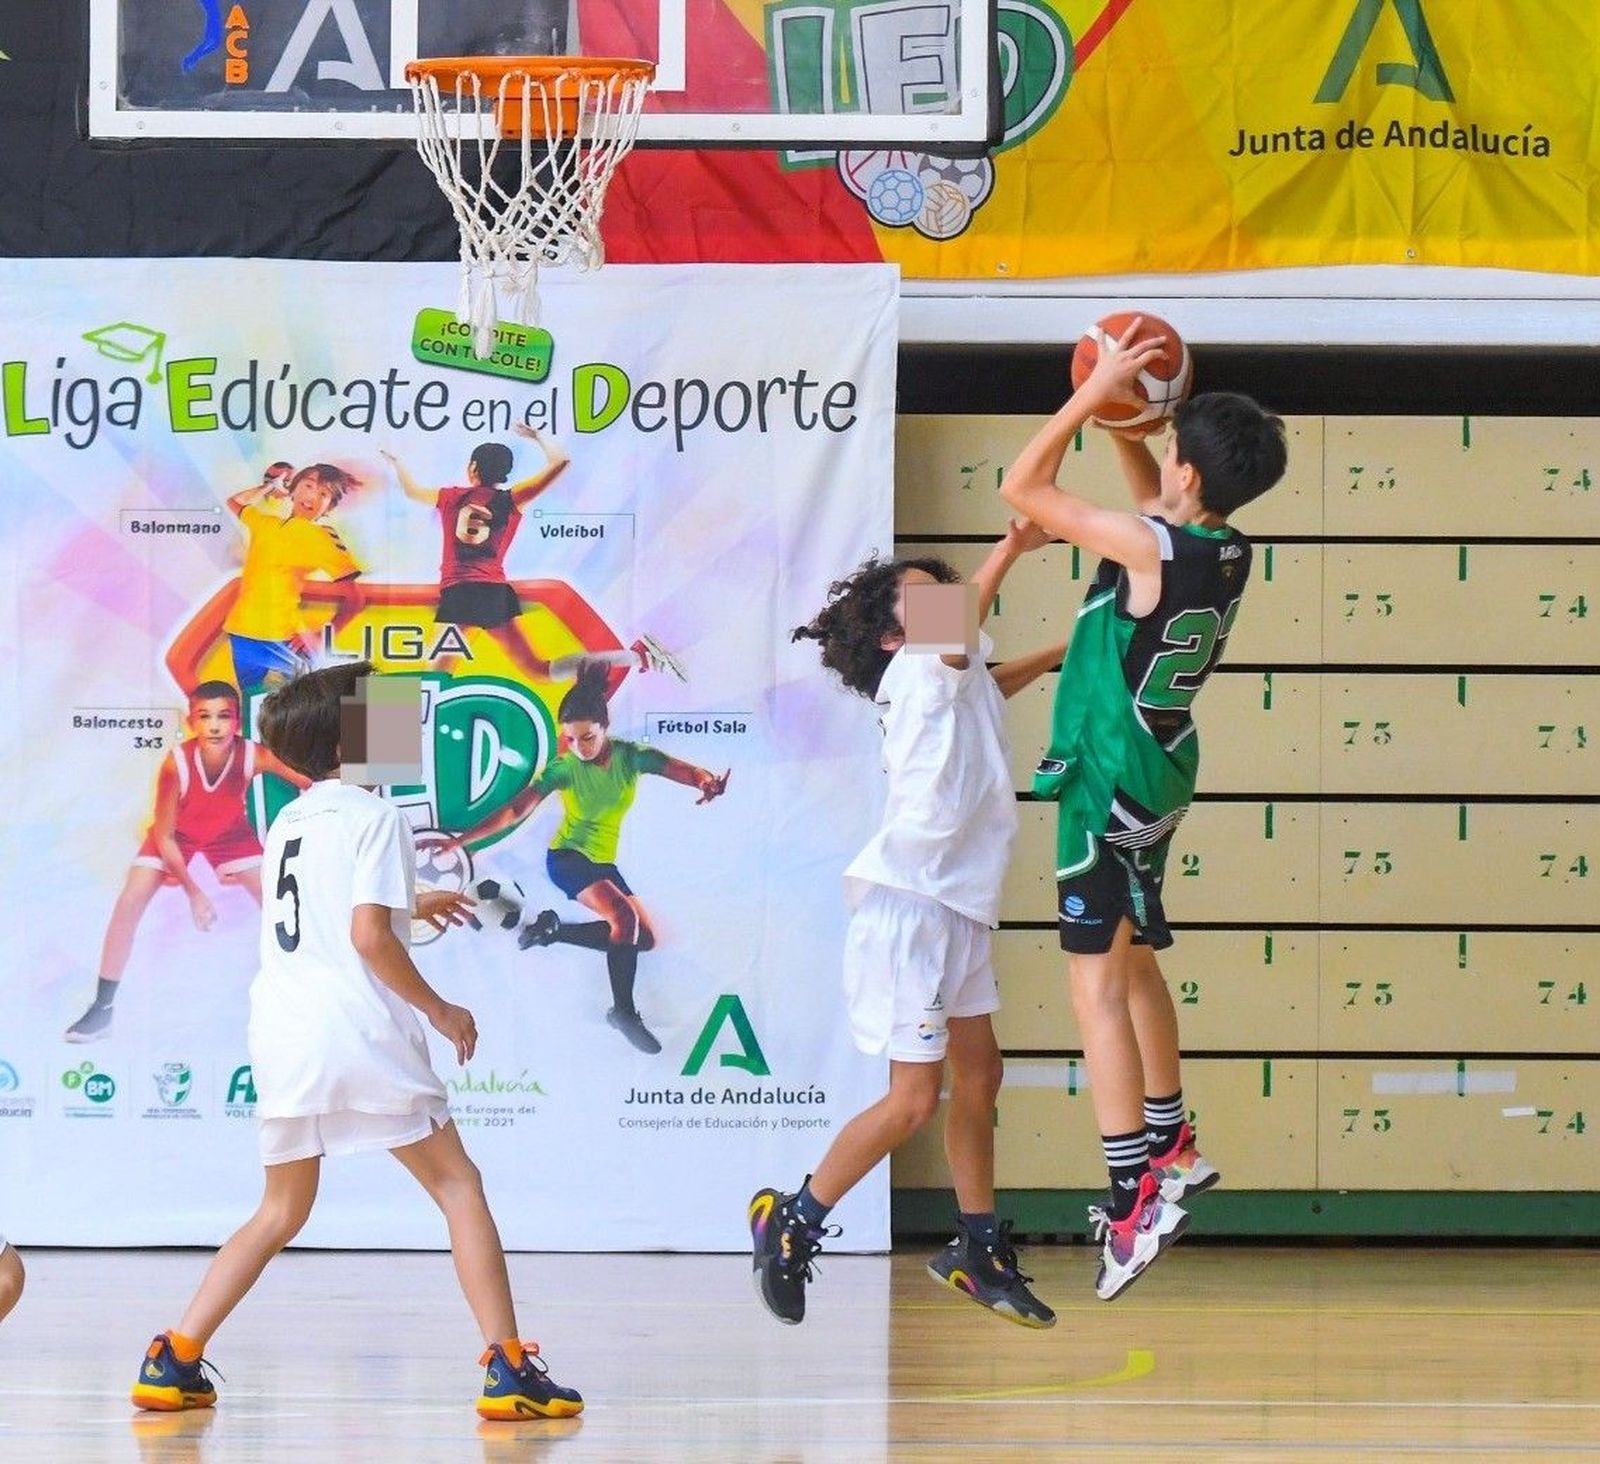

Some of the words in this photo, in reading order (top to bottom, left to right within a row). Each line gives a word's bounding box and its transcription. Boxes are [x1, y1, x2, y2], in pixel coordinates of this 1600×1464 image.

[1228, 124, 1326, 157] Junta
[1335, 120, 1374, 150] de
[1383, 119, 1551, 158] Andalucía
[420, 337, 458, 357] CON
[490, 351, 541, 372] COLE!
[2, 357, 143, 450] Liga
[165, 356, 451, 433] Edúcate
[462, 399, 512, 432] en
[523, 386, 558, 436] el
[572, 362, 858, 453] Deporte
[130, 520, 222, 535] Balonmano
[455, 502, 493, 545] 6
[539, 524, 605, 539] Voleibol
[323, 624, 474, 661] LIGA
[72, 715, 164, 730] Baloncesto
[657, 719, 709, 735] Fútbol
[712, 719, 747, 734] Sala
[133, 736, 164, 750] 3x3
[1181, 853, 1200, 877] 2
[1539, 854, 1589, 878] 74
[275, 836, 303, 953] 5
[1180, 980, 1199, 1005] 2
[1537, 980, 1587, 1005] 74
[445, 1069, 550, 1096] ndalucía
[624, 1087, 685, 1105] Junta
[690, 1087, 716, 1105] de
[721, 1085, 826, 1105] Andalucía
[483, 1118, 515, 1127] 2021
[618, 1116, 684, 1131] Consejería
[686, 1116, 702, 1129] de
[704, 1116, 768, 1129] Educación
[771, 1119, 778, 1131] y
[781, 1117, 831, 1131] Deporte
